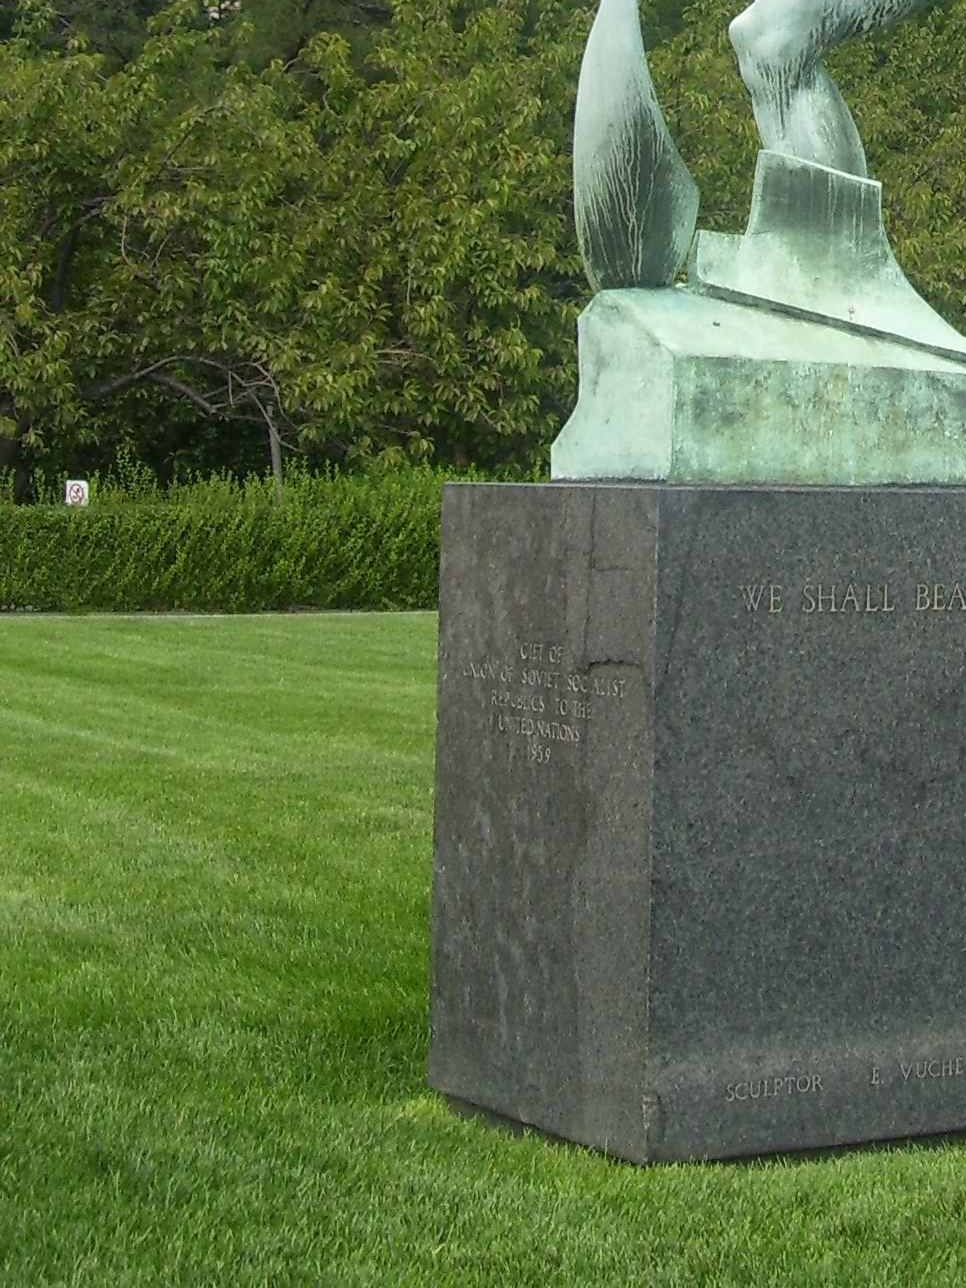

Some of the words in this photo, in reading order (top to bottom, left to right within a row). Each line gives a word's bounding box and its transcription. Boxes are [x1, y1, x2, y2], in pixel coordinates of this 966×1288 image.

[737, 584, 784, 613] WE
[801, 583, 896, 613] SHALL
[500, 665, 514, 683] OF
[521, 666, 560, 689] SOVIET
[567, 673, 626, 698] SOCALIST
[554, 697, 568, 717] TO
[573, 700, 593, 720] THE
[498, 714, 534, 736] UNTED
[536, 720, 581, 743] NATIONS
[725, 1074, 824, 1103] SCULPTOR
[869, 1066, 886, 1086] E.
